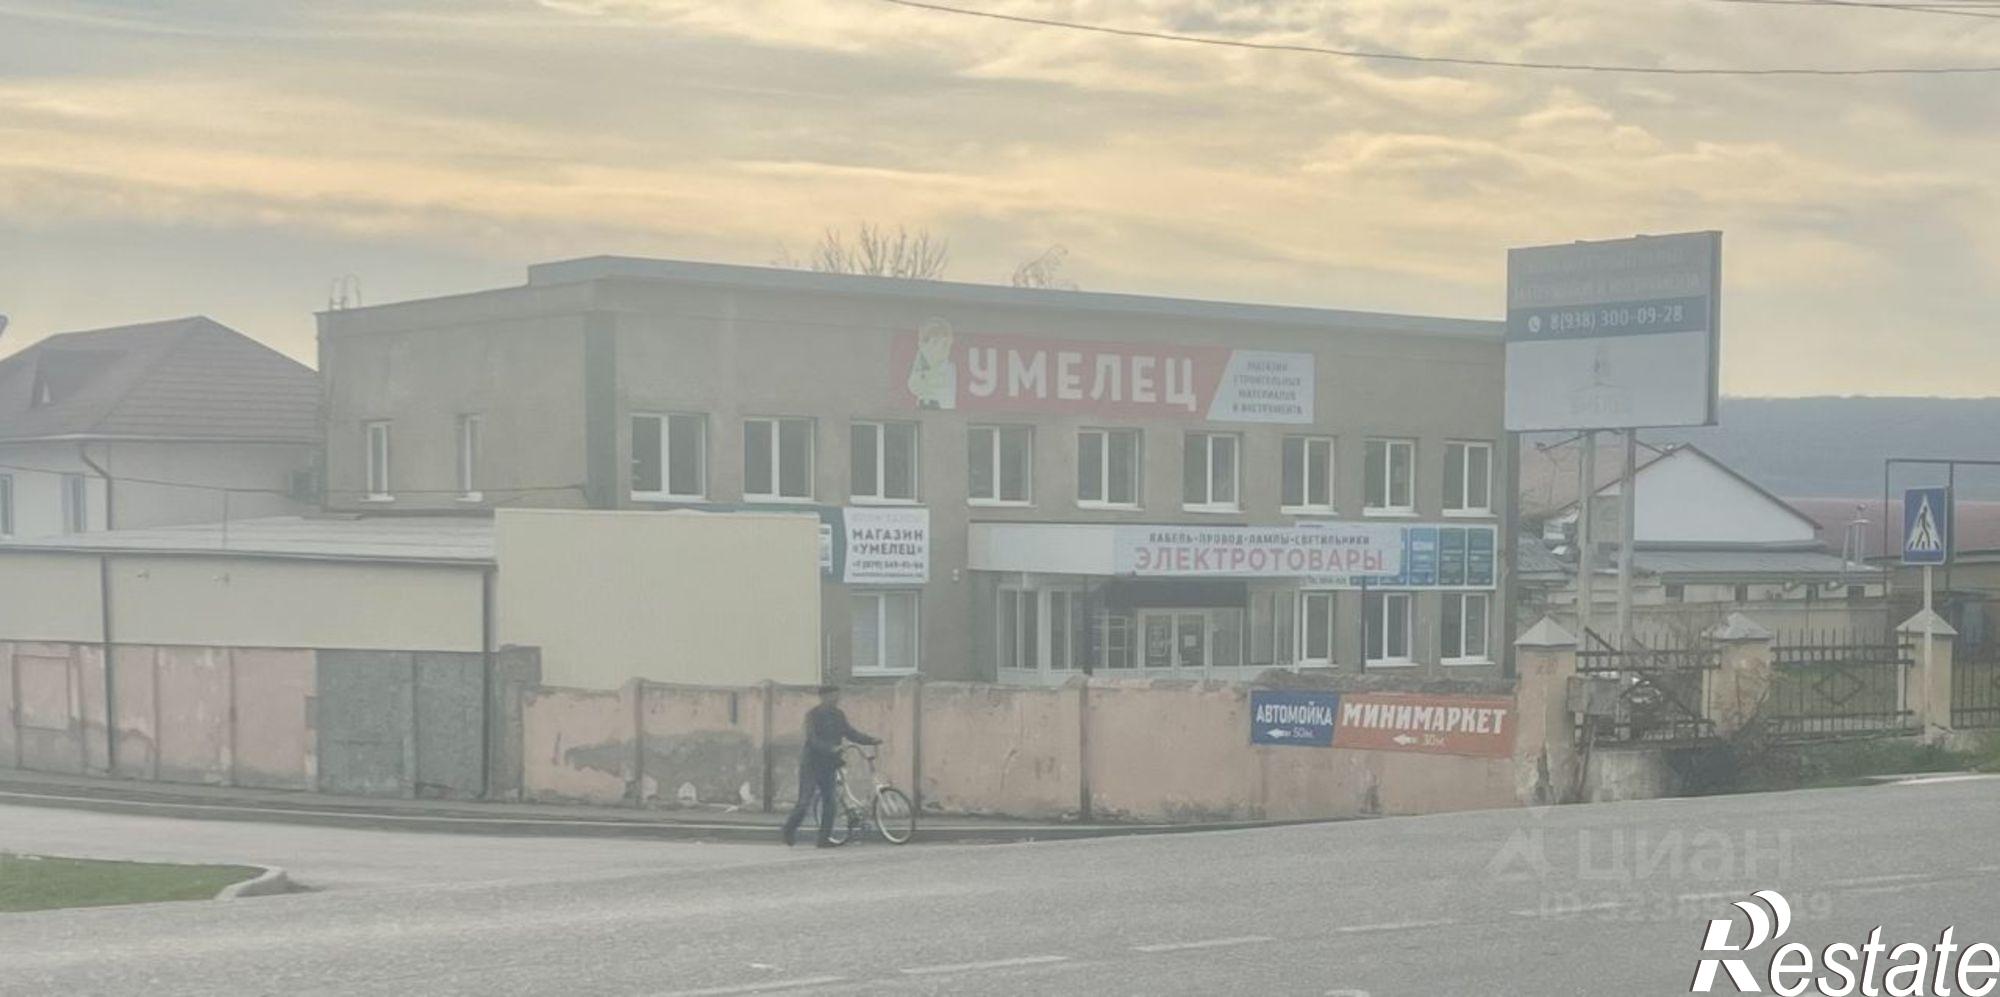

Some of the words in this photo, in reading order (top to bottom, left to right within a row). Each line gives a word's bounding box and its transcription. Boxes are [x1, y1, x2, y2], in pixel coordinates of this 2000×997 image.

[1601, 304, 1683, 326] 300-09-28
[968, 347, 1197, 411] УМЕЛЕЦ
[852, 528, 923, 541] МАГАЗИН
[1135, 547, 1383, 571] ЭЛЕКТРОТОВАРЫ
[1256, 701, 1333, 726] АВТОМОЙКА
[1342, 703, 1506, 735] МИНИМАРКЕТ
